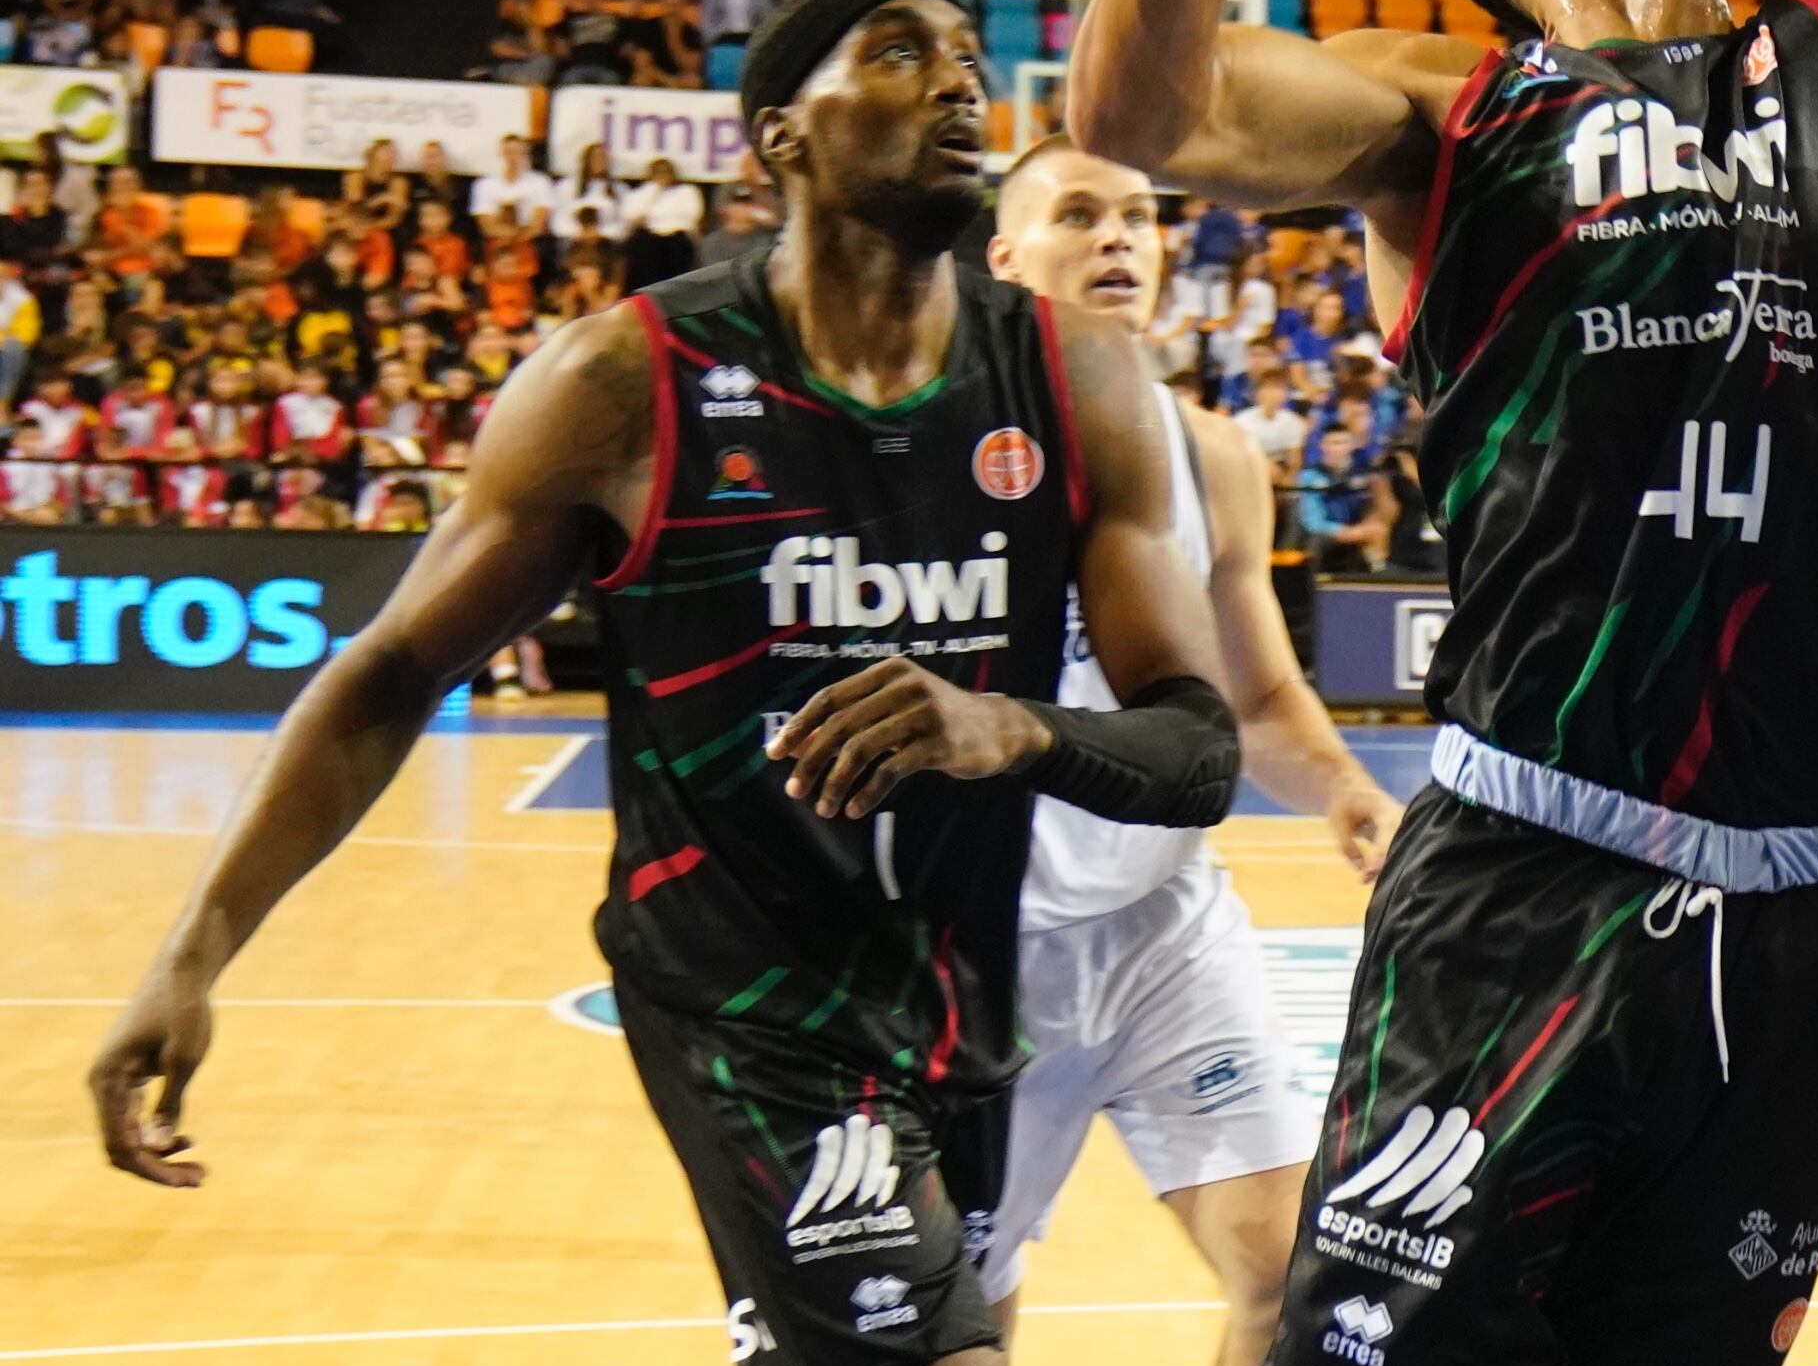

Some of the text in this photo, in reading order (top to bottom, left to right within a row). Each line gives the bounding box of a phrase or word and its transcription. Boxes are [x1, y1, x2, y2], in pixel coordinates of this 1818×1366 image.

[1566, 98, 1789, 207] fibwi
[1576, 216, 1648, 243] FIBRA
[760, 531, 1009, 628] fibwi
[1354, 1249, 1391, 1275] ILLES
[1389, 1261, 1443, 1290] BALEARS
[1781, 1252, 1806, 1277] de
